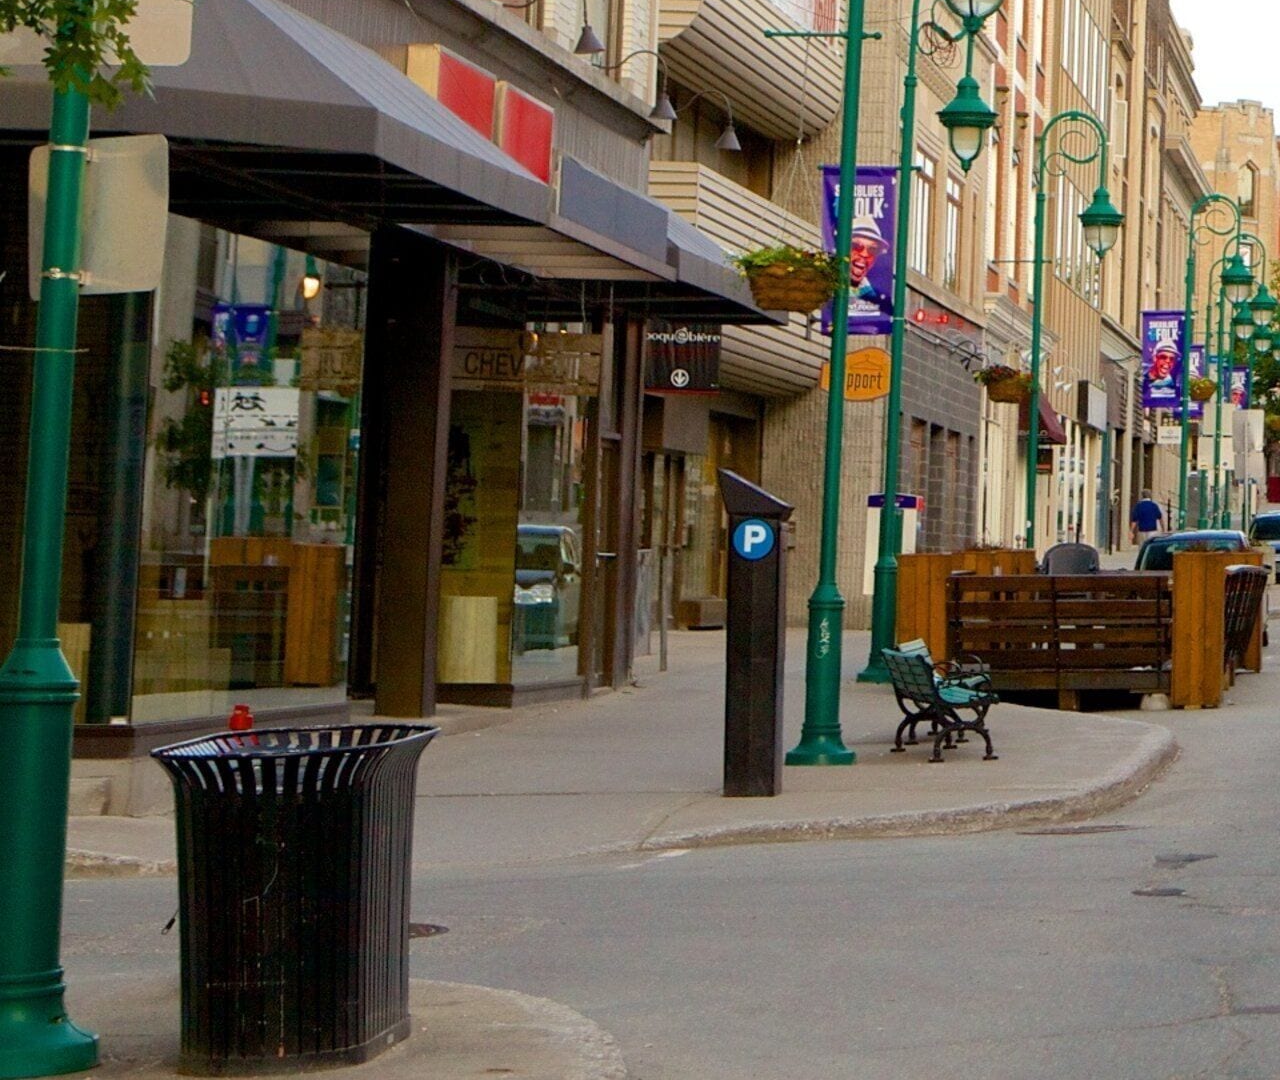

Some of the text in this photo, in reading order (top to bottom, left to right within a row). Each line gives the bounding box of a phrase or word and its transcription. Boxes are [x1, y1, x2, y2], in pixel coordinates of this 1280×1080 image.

[834, 184, 885, 198] SBLUES
[846, 372, 883, 392] pport
[743, 524, 767, 553] P
